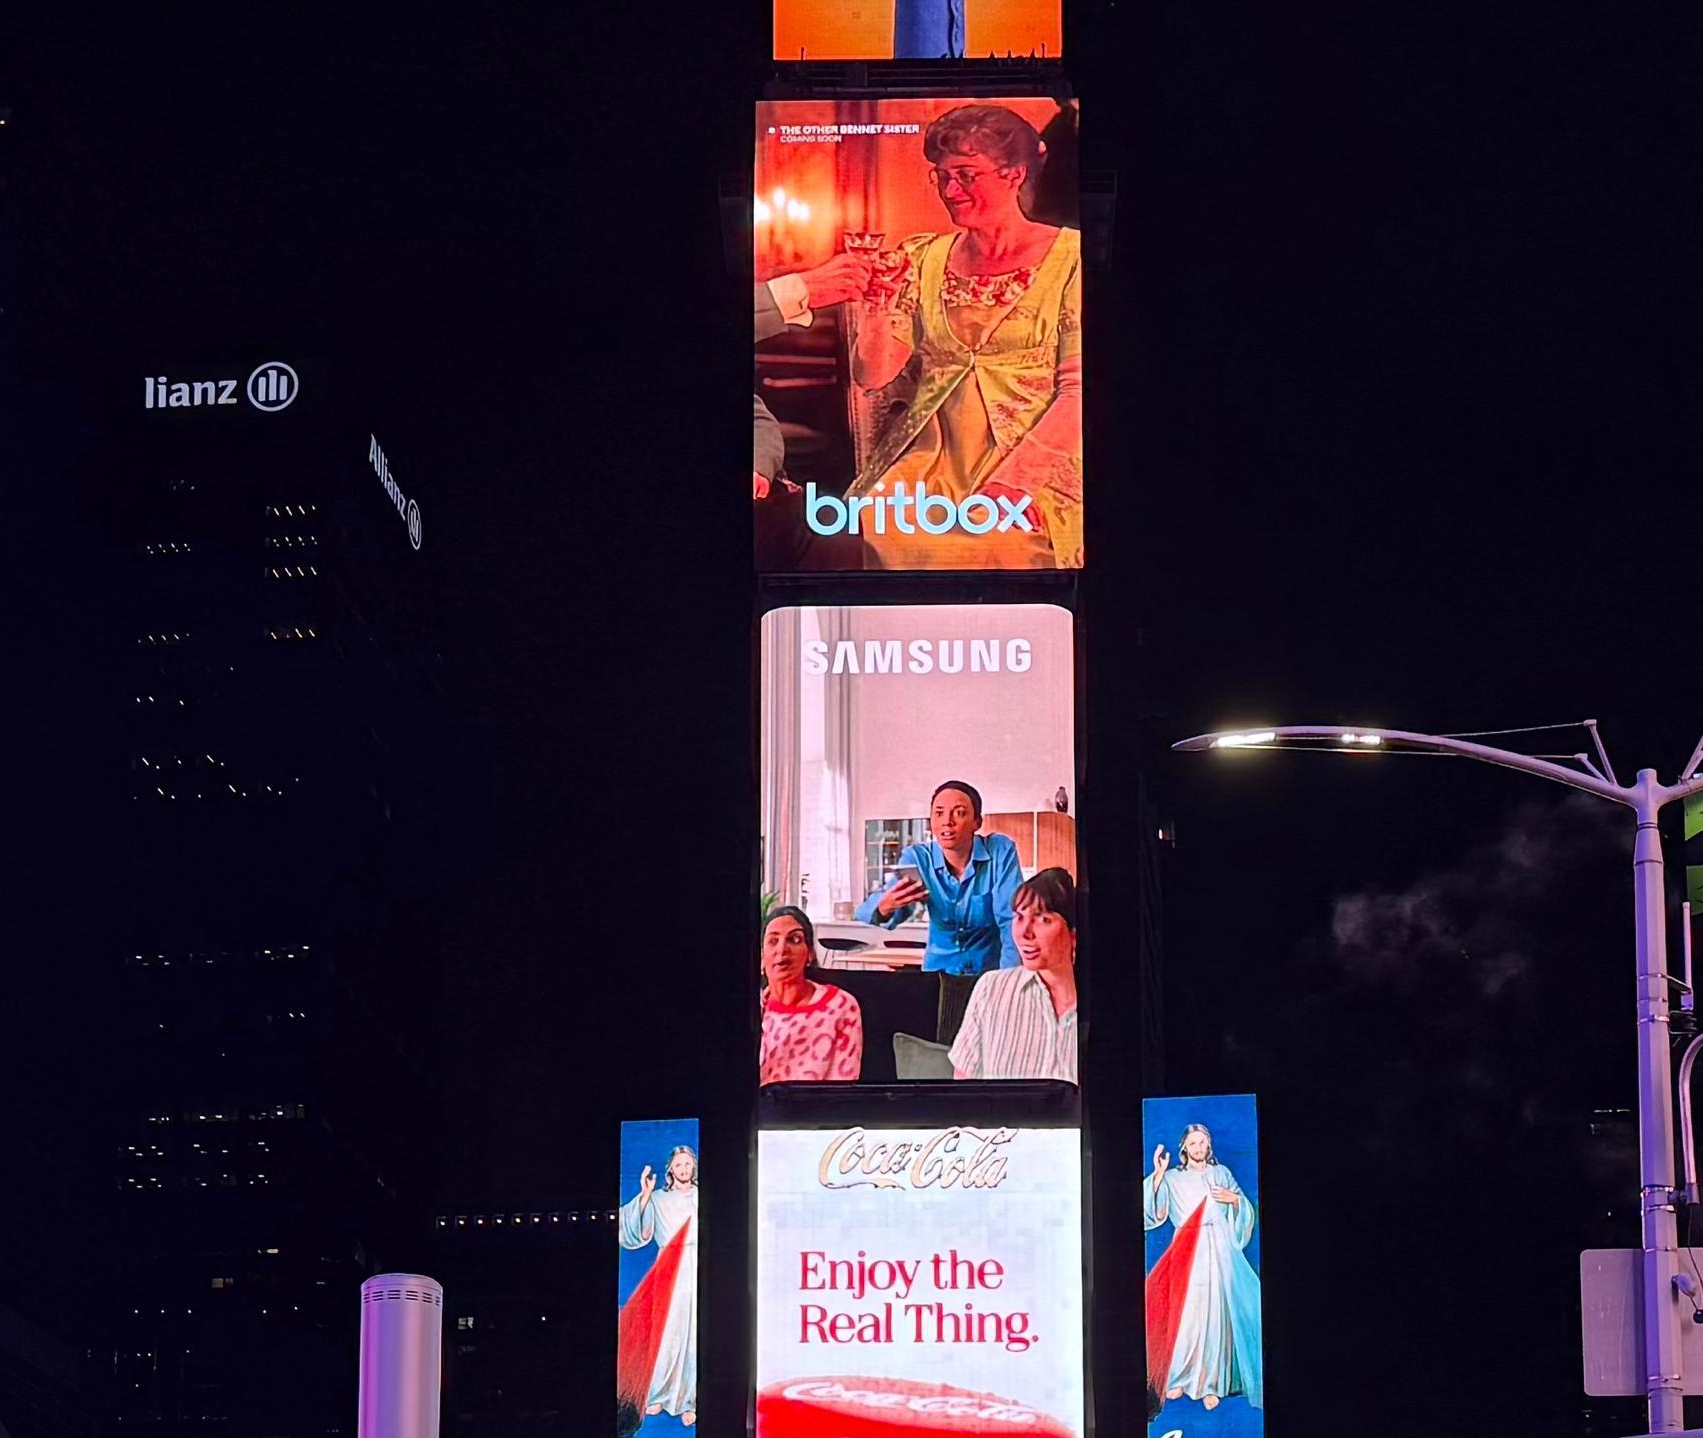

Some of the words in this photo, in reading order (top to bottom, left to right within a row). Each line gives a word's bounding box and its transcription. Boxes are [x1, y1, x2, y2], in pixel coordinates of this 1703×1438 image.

[780, 125, 801, 135] THE
[803, 125, 838, 135] OTHER
[840, 124, 882, 135] BENNET
[883, 124, 920, 135] SISTER
[369, 433, 407, 521] Allianz
[805, 482, 1033, 536] britbox
[804, 638, 1033, 675] SAMSUNG
[818, 1126, 1020, 1191] Coca-Cola
[799, 1251, 921, 1299] Enjoy
[933, 1250, 1004, 1290] the
[799, 1304, 893, 1345] Real
[903, 1303, 1039, 1353] Thing.
